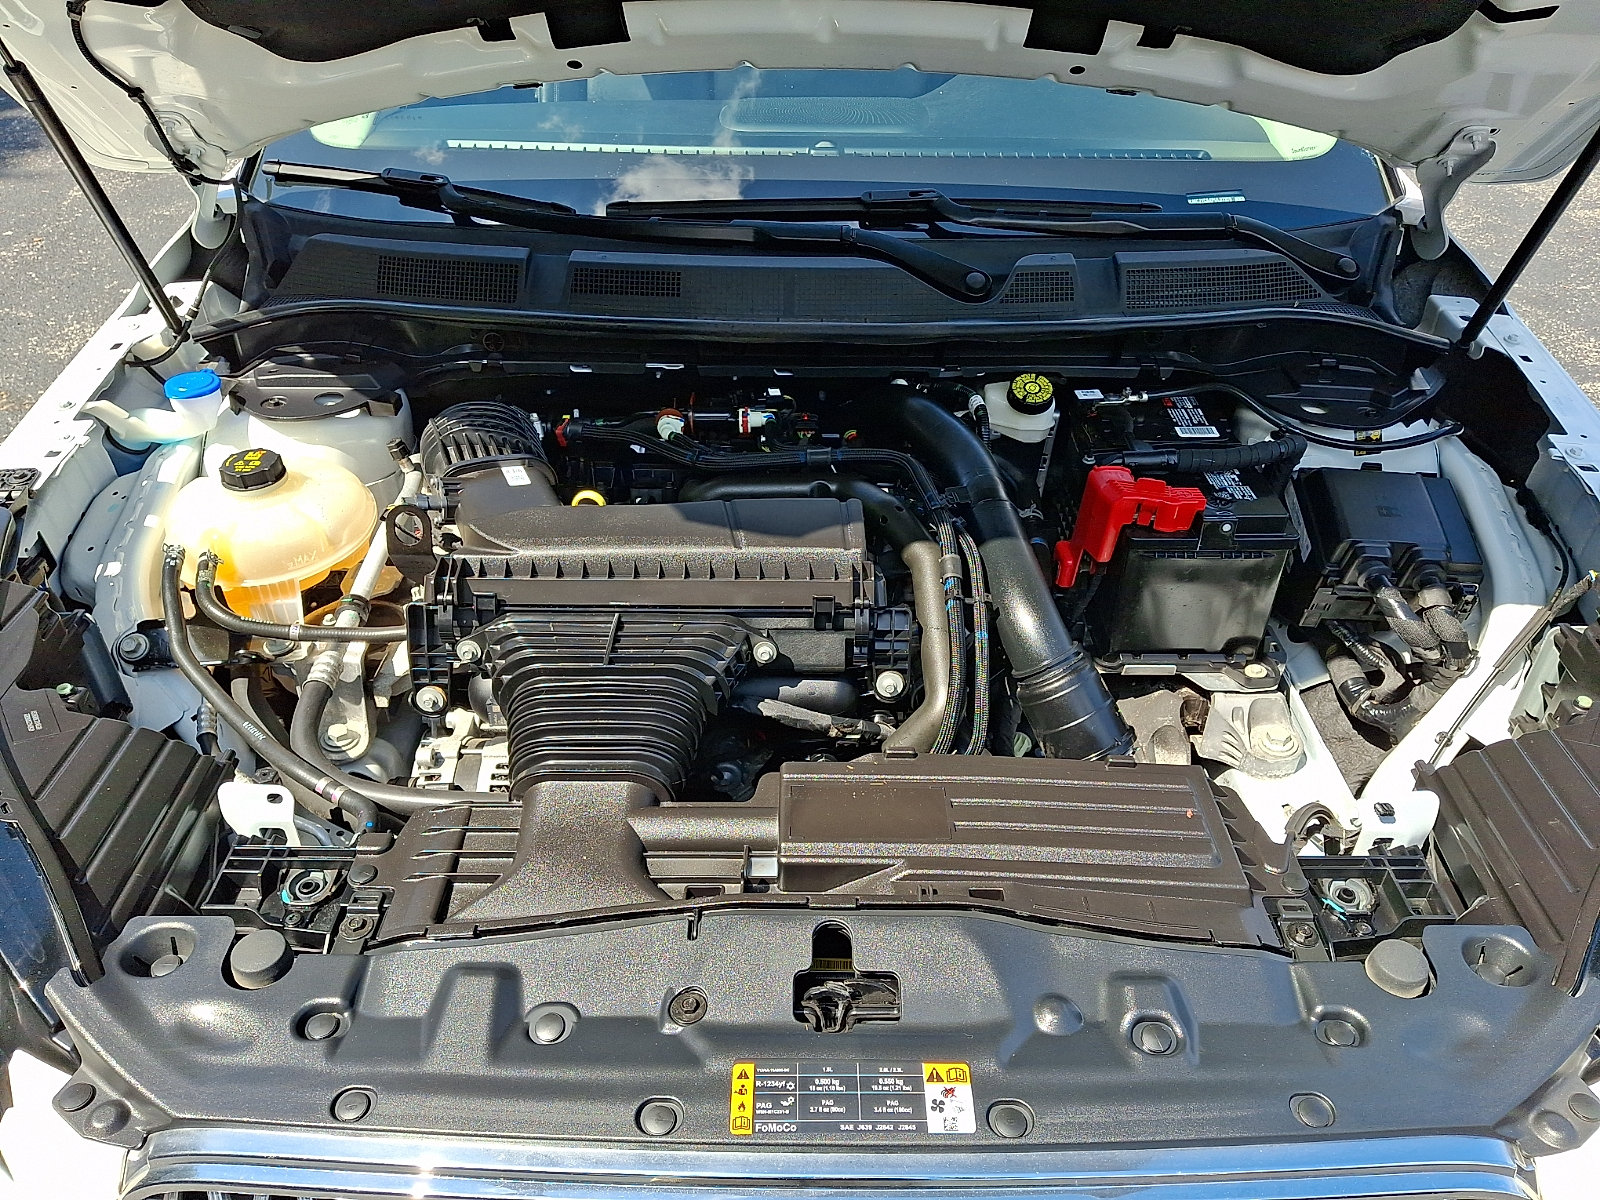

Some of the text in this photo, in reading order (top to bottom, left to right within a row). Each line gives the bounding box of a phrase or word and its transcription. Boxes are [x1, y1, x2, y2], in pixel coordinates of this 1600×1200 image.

[755, 1080, 786, 1089] R-1234yf
[831, 1078, 840, 1086] kg
[895, 1078, 904, 1086] kg
[755, 1122, 797, 1133] FoMoCo
